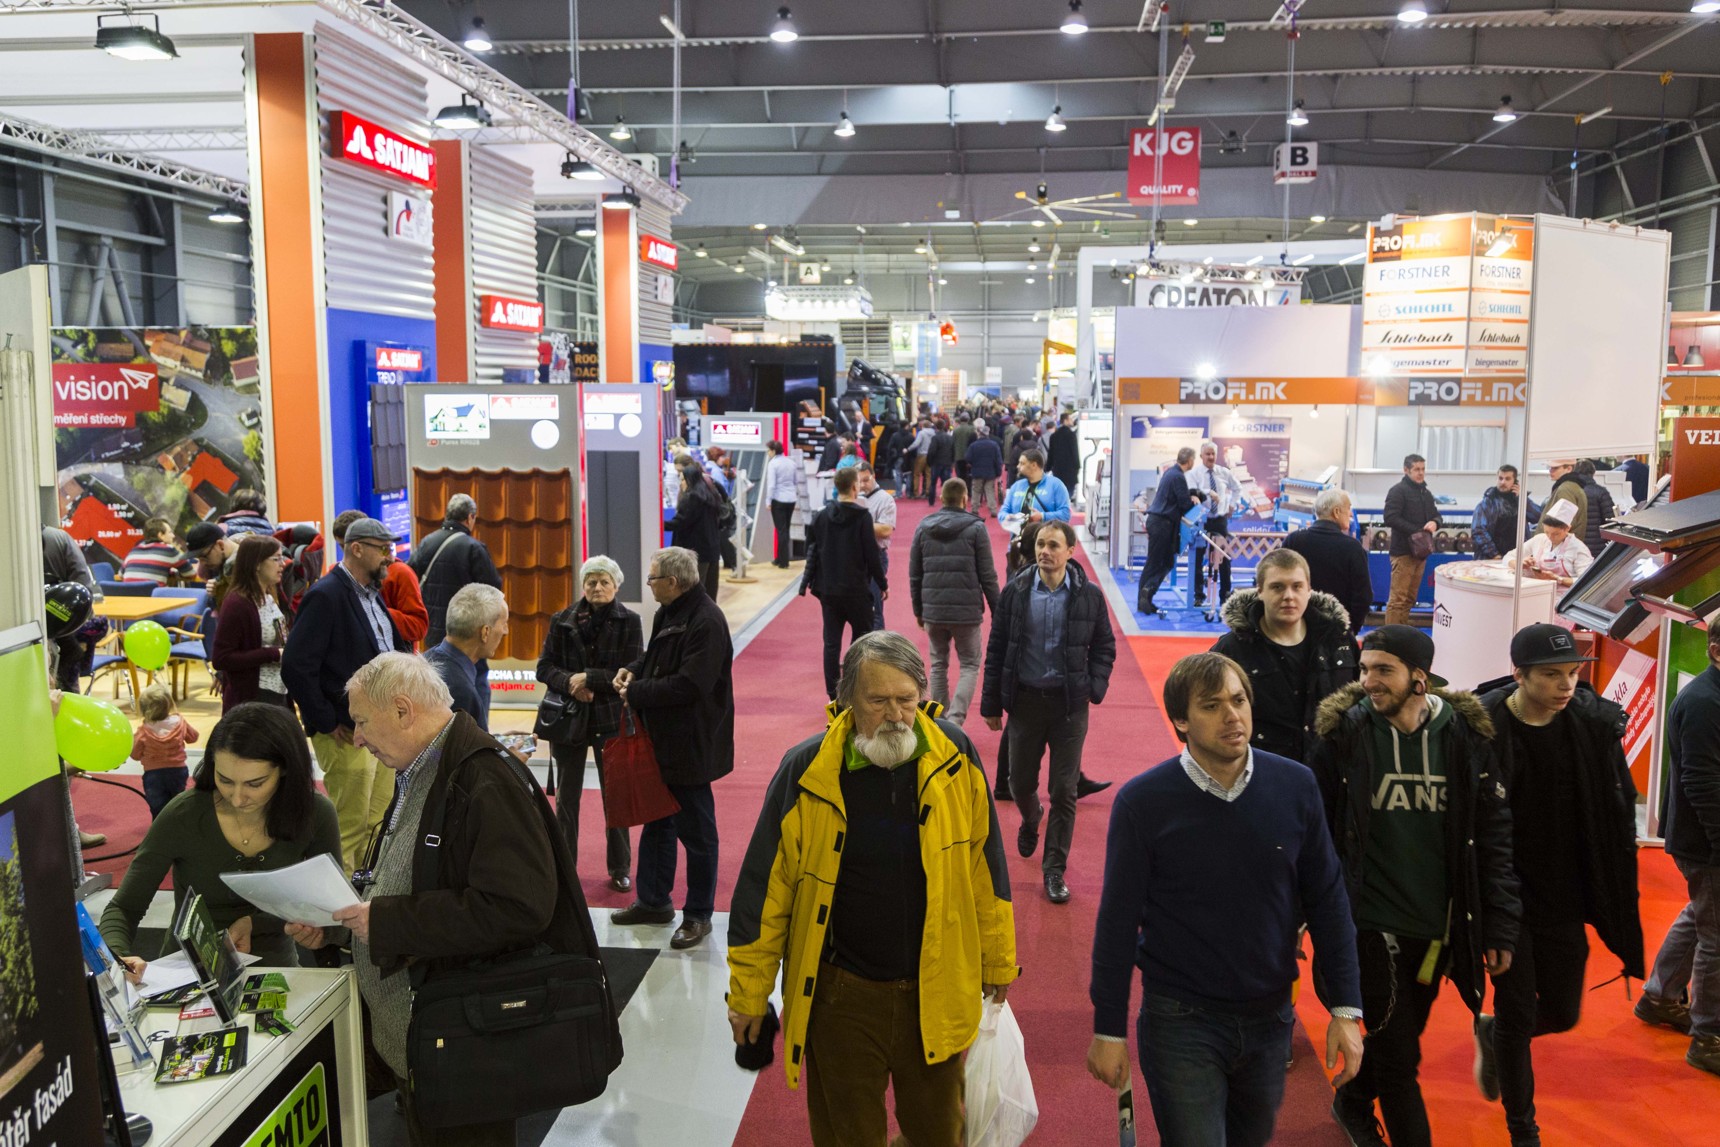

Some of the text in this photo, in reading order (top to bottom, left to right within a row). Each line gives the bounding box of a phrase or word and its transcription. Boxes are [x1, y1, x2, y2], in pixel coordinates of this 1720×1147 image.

[1133, 131, 1194, 156] KJG
[373, 133, 430, 181] SATJAM
[1290, 146, 1309, 166] B
[1140, 185, 1183, 194] QUALITY
[804, 266, 813, 276] A
[1380, 265, 1450, 281] FORSTNER
[1480, 265, 1521, 279] FORSTNER
[1149, 284, 1268, 307] CREATON
[55, 375, 129, 401] vision
[90, 413, 127, 427] střechy
[1232, 423, 1285, 433] FORSTNER
[1371, 773, 1448, 812] VANS
[35, 1054, 74, 1131] fasád
